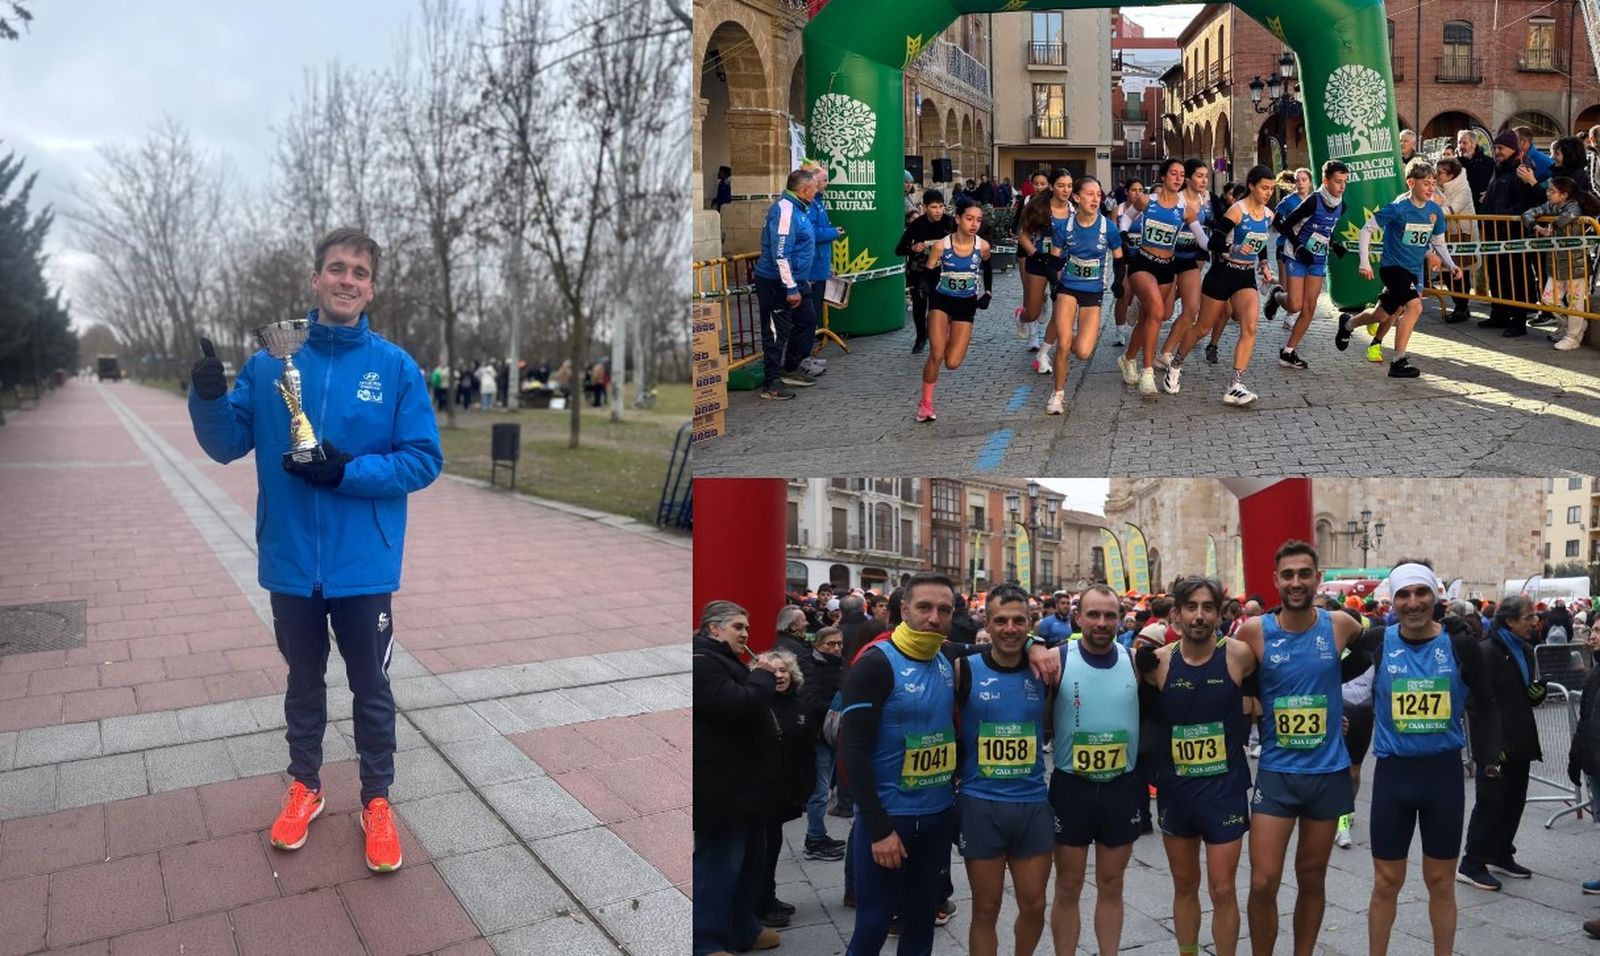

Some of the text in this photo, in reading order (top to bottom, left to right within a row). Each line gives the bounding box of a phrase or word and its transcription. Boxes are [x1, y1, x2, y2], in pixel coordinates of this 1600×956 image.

[1344, 157, 1395, 172] NDACION
[1362, 167, 1396, 180] RURAL
[822, 190, 877, 200] NDACION
[835, 200, 877, 211] RURAL
[1146, 227, 1173, 244] 155
[1410, 231, 1428, 245] 36
[1073, 264, 1091, 278] 38
[948, 278, 967, 291] 63
[1396, 693, 1442, 716] 1247
[1278, 713, 1320, 734] 823
[983, 738, 1028, 761] 1058
[1175, 738, 1217, 761] 1073
[911, 745, 948, 772] 1041
[1077, 748, 1120, 771] 987
